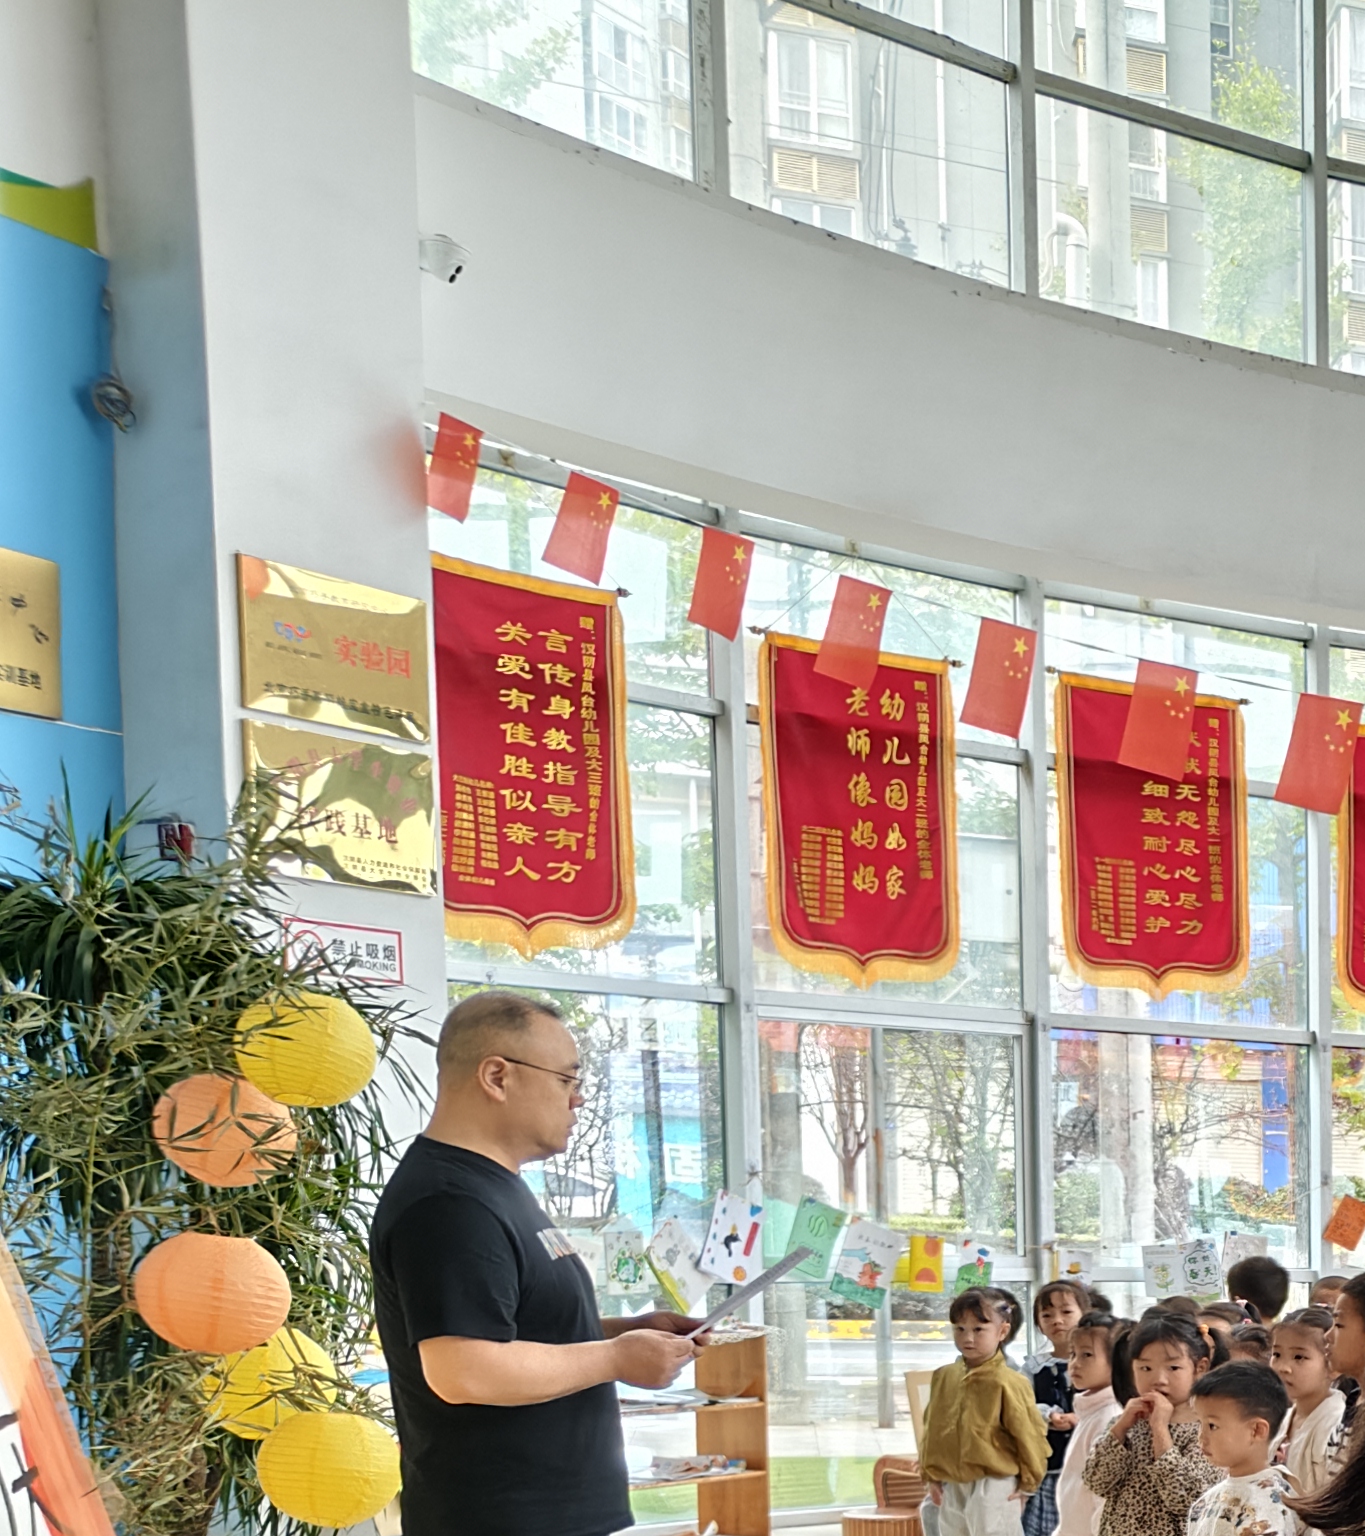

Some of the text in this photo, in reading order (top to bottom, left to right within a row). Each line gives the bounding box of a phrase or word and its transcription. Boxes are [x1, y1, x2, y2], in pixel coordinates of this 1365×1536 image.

[333, 634, 412, 680] 实验园
[495, 621, 541, 882] 关爱有佳胜似亲人
[537, 629, 583, 884] 言传身教指导有方
[845, 686, 880, 895] 老师像妈妈
[878, 688, 911, 901] 幼儿园如家
[1140, 780, 1173, 934] 细致耐心爱护
[331, 938, 397, 962] 禁止吸烟
